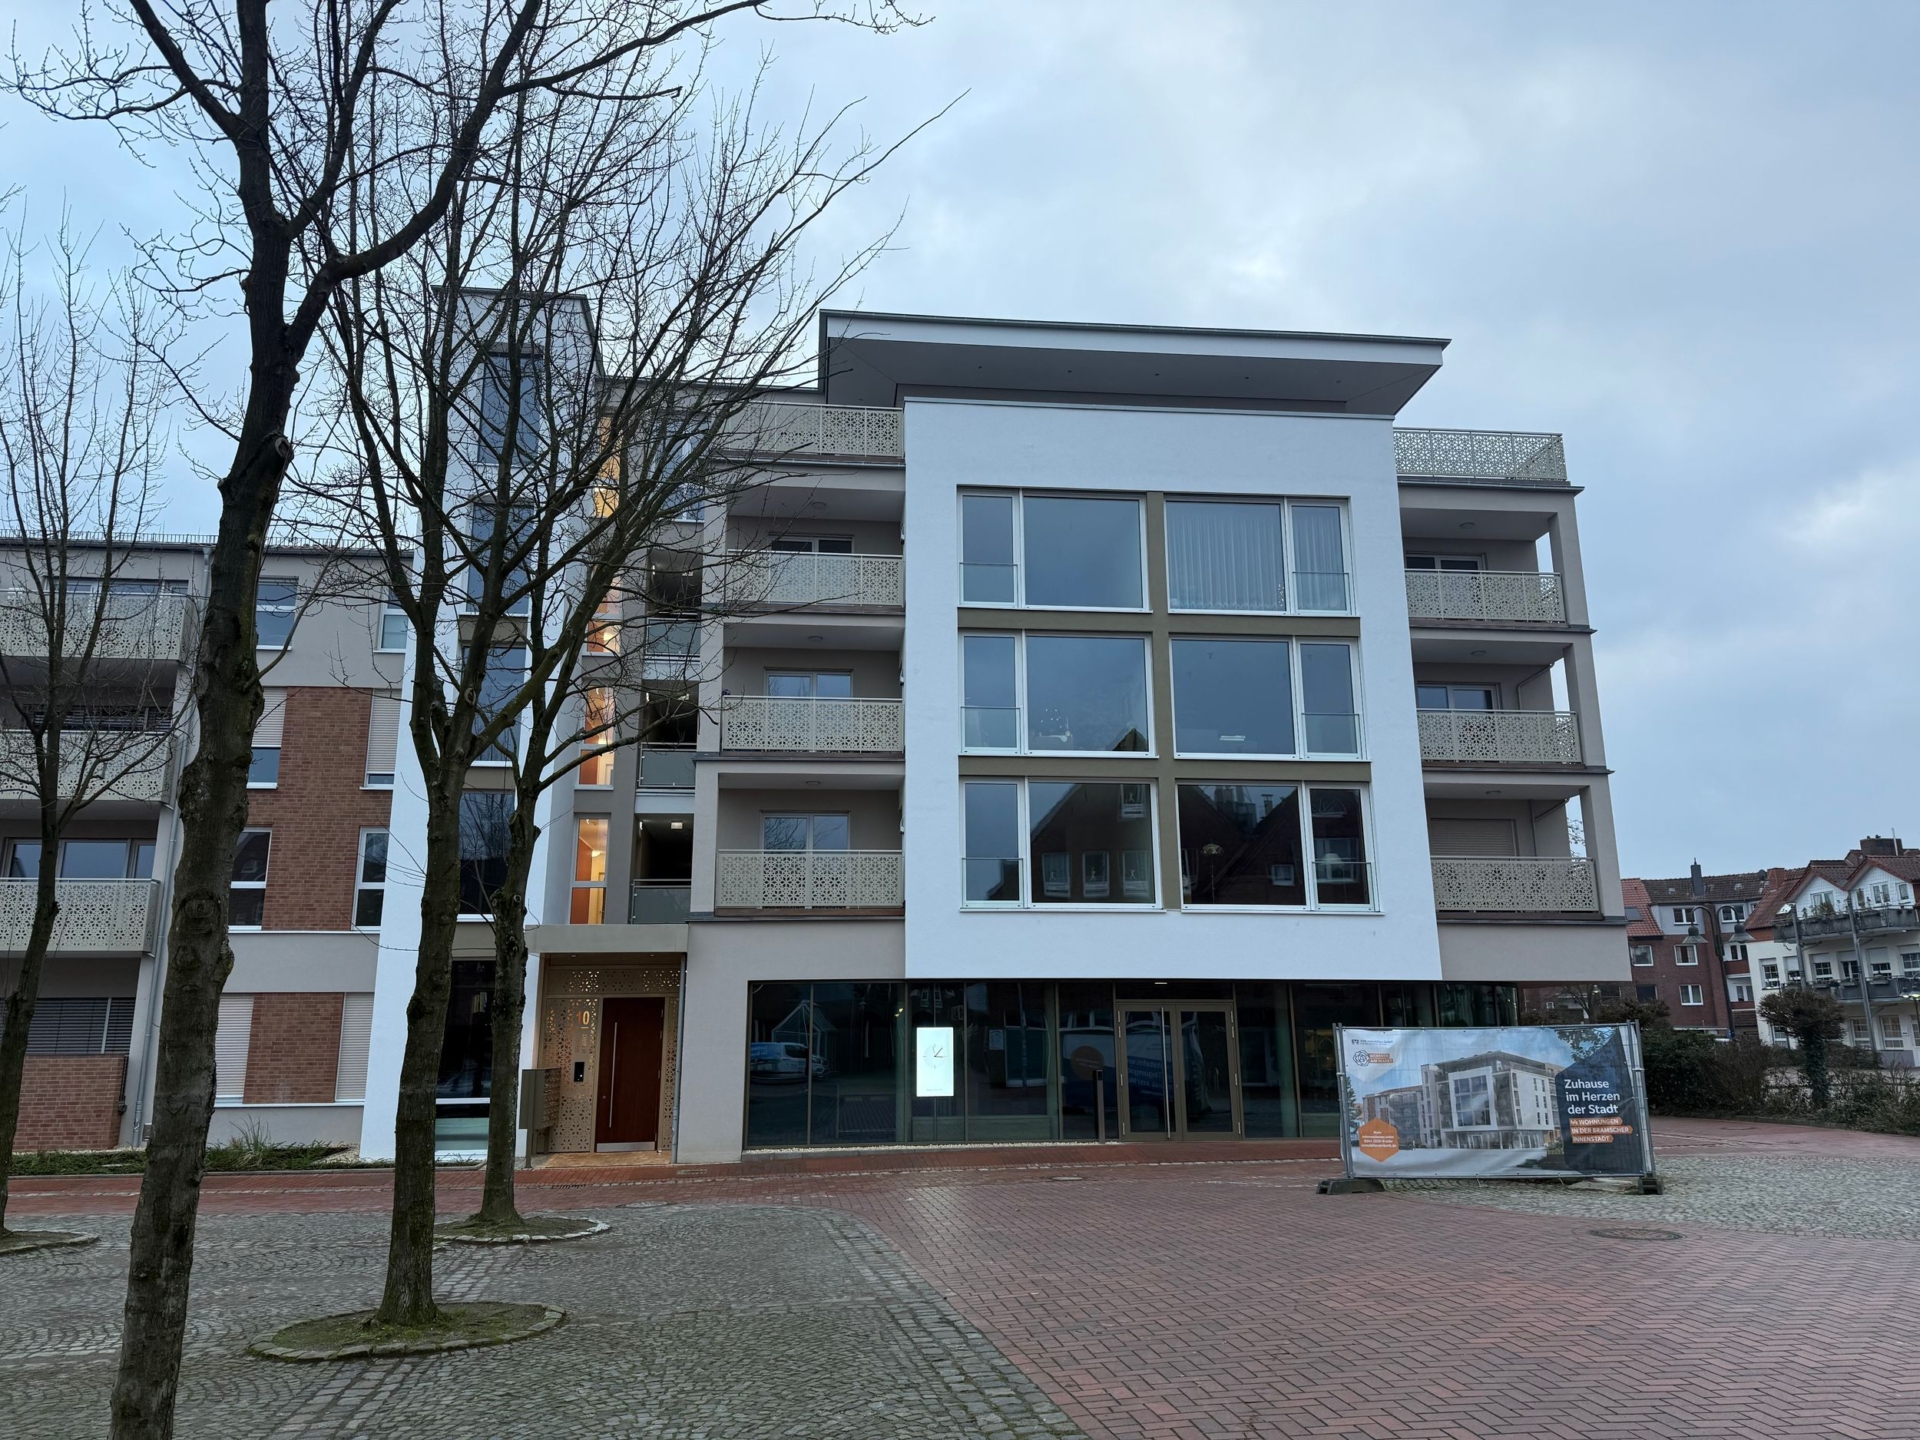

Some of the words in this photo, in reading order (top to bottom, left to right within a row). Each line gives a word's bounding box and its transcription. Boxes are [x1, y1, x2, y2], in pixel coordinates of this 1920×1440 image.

[576, 1010, 590, 1025] 10
[1564, 1078, 1609, 1089] Zuhause
[1565, 1092, 1579, 1102] im
[1582, 1092, 1620, 1101] Herzen
[1567, 1104, 1586, 1114] der
[1588, 1104, 1618, 1114] Stadt
